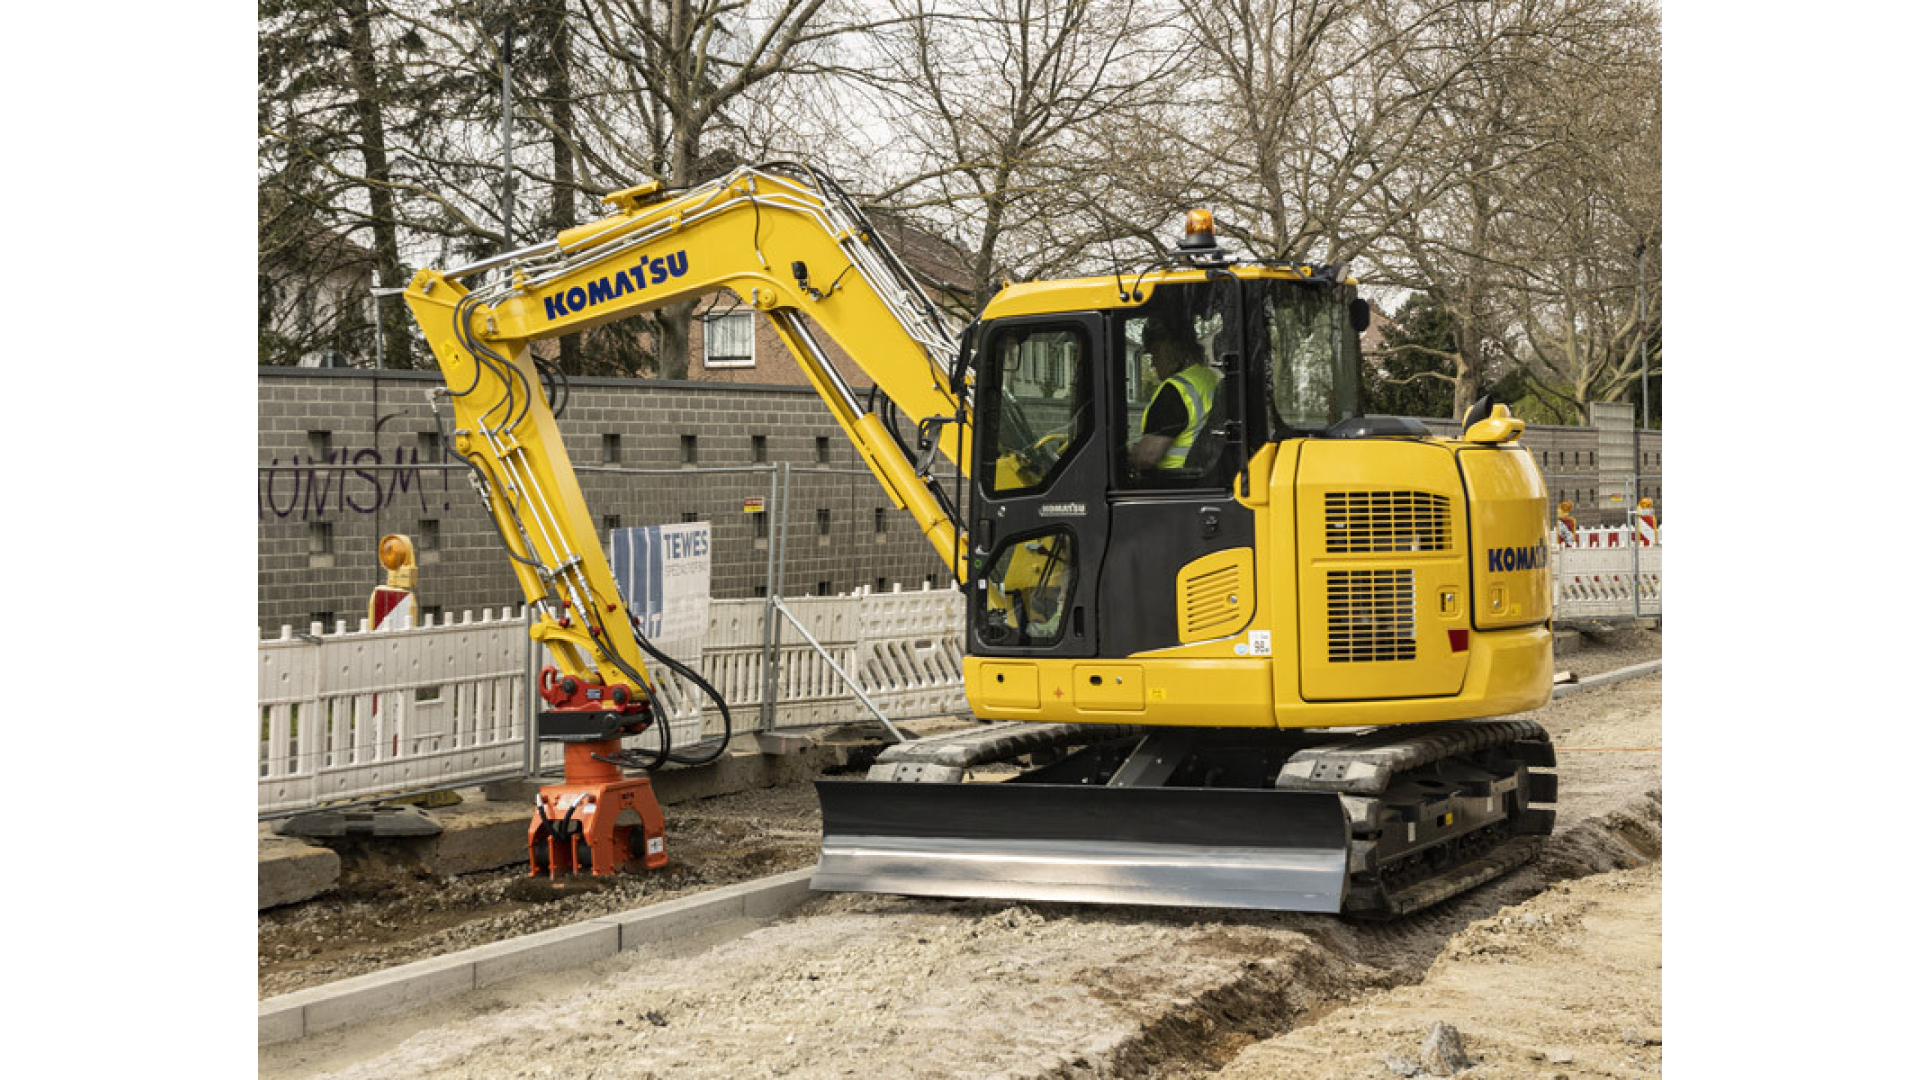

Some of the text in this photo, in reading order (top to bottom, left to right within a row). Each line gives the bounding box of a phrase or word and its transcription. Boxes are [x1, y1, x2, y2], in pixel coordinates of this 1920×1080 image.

[544, 250, 689, 320] KOMATSU
[258, 436, 450, 520] UNISM!
[664, 530, 709, 559] TEWES
